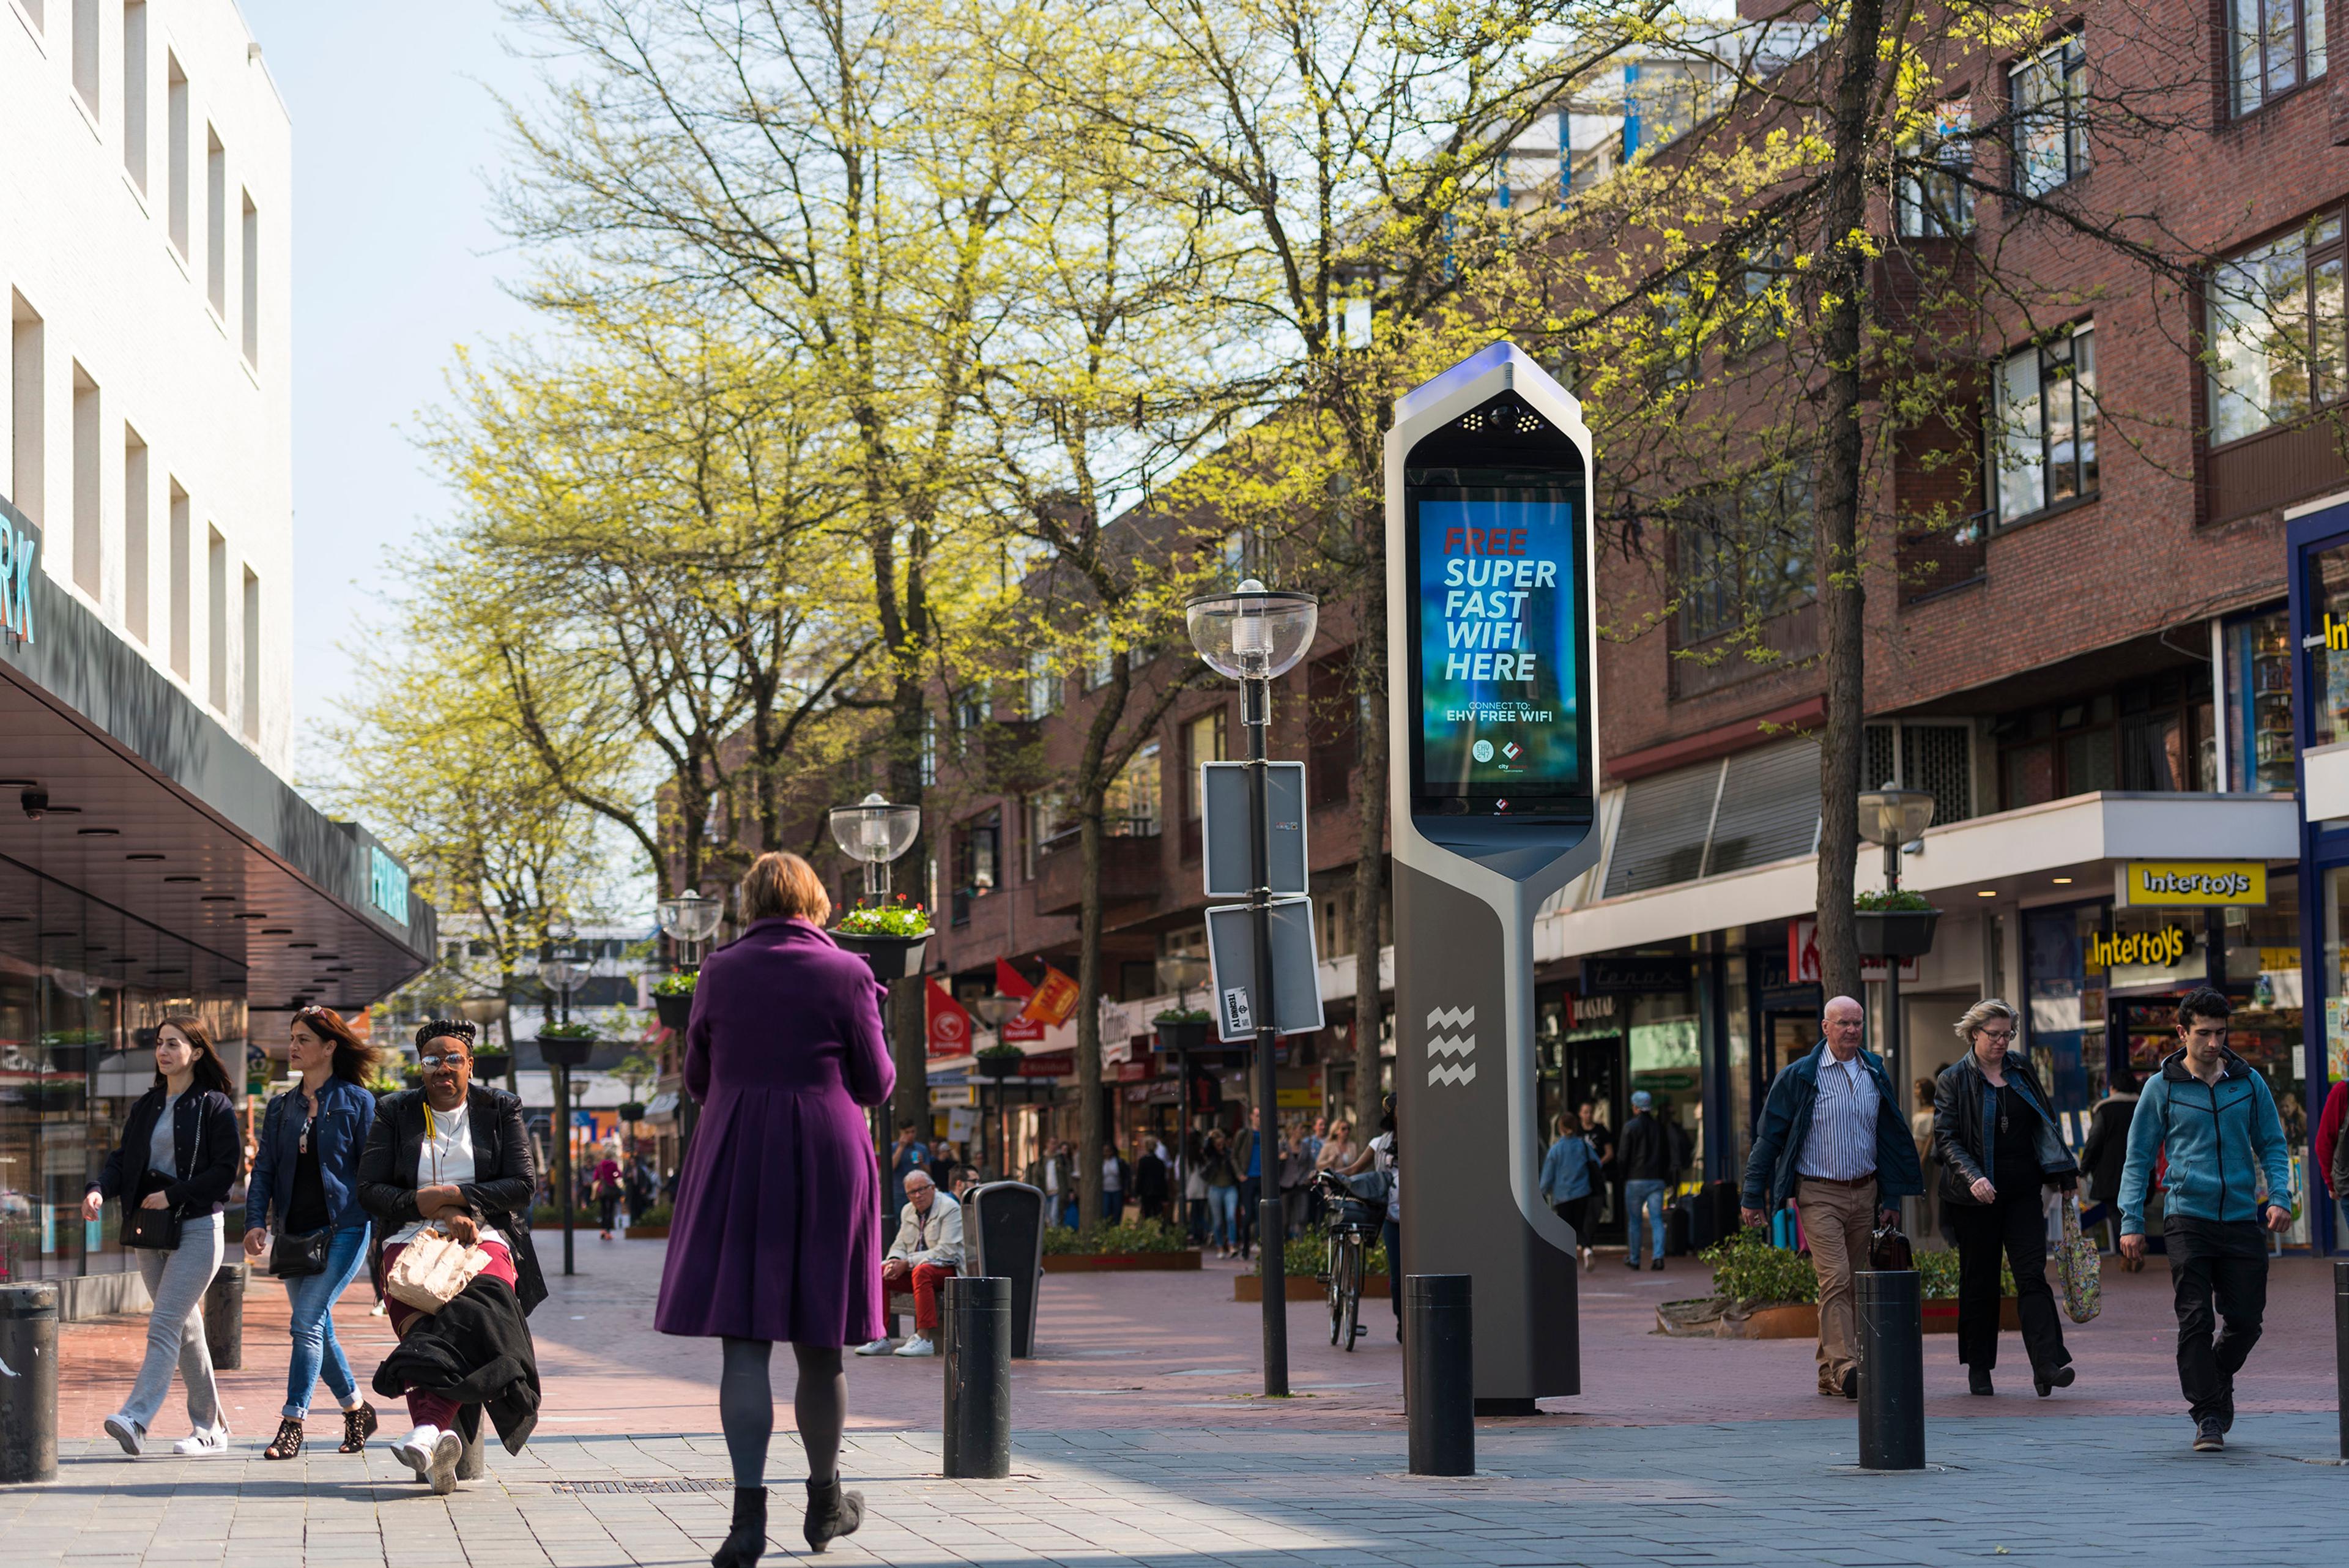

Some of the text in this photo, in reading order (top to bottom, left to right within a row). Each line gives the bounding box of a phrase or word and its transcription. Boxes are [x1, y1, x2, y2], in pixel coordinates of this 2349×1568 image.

[1444, 527, 1527, 555] FREE
[1444, 558, 1557, 588] SUPER
[1445, 590, 1529, 619] FAST
[1447, 622, 1523, 649] WIFI
[2323, 611, 2349, 651] In
[1445, 653, 1537, 681] HERE
[1447, 710, 1553, 722] EHV FREE WIFI
[2143, 868, 2251, 897] Intertoys
[2093, 923, 2184, 967] Intertoys
[1228, 994, 1241, 1028] TECHNO TV
